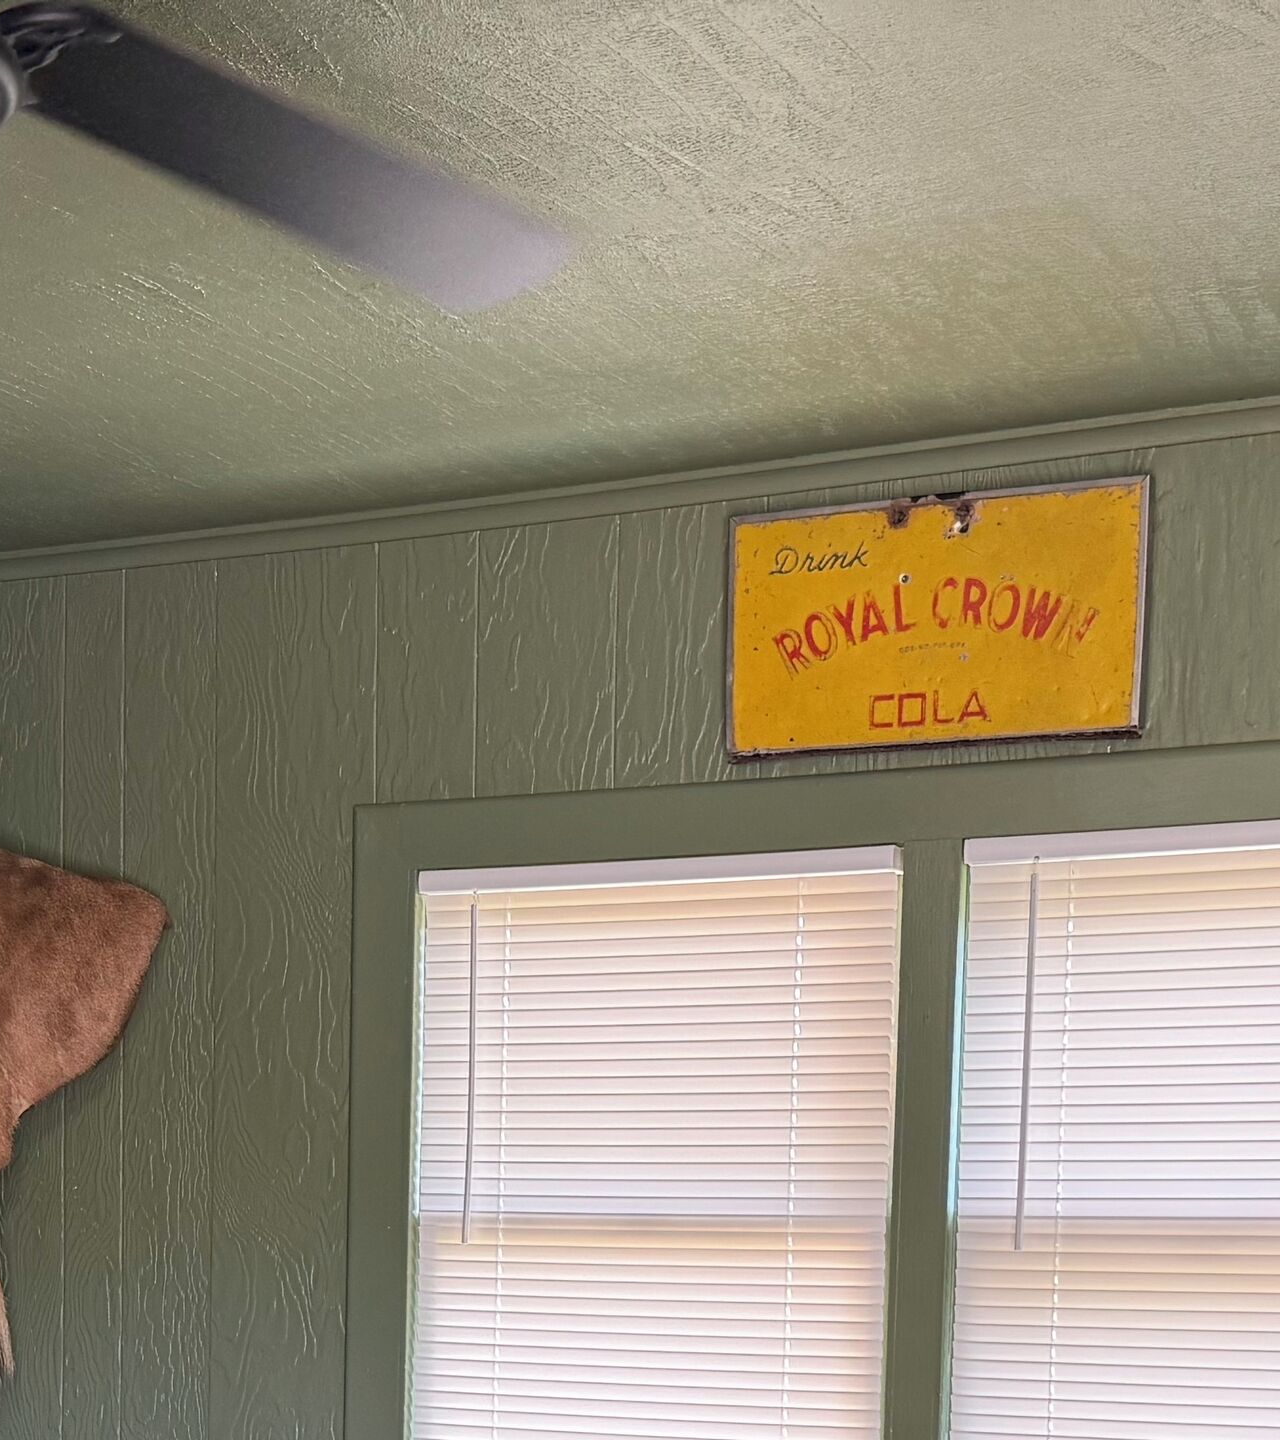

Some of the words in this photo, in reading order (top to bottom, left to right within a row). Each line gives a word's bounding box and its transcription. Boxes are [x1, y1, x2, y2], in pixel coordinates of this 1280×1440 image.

[769, 541, 868, 575] Drink
[773, 581, 917, 680] ROYAL
[930, 577, 1100, 658] CROWN
[869, 688, 991, 729] COLA
